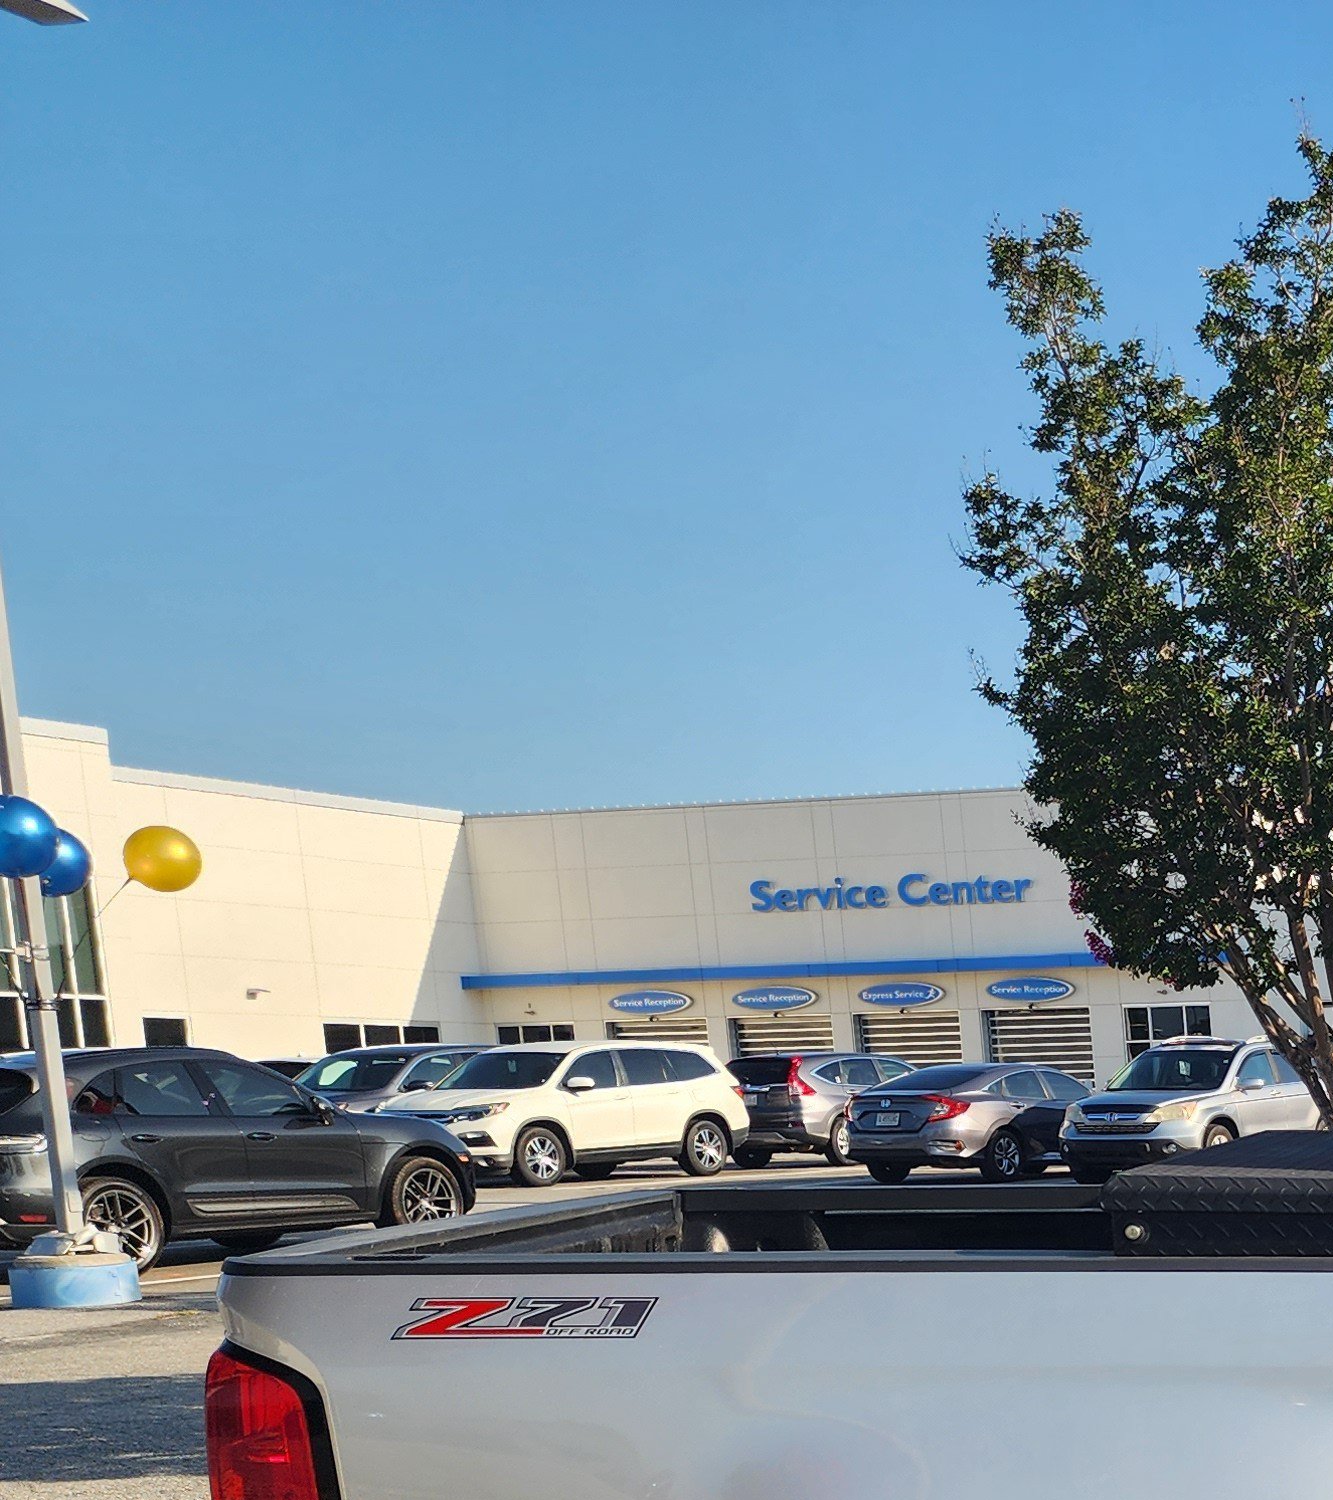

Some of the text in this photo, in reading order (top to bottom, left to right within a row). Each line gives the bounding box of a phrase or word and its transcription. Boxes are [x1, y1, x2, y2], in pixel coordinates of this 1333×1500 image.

[749, 872, 1034, 913] Service Center
[862, 989, 925, 1002] Express Service
[991, 984, 1067, 996] Service Reception
[613, 997, 684, 1009] Service Reception
[737, 991, 810, 1004] Service Reception
[391, 1297, 658, 1339] Z71
[545, 1327, 635, 1336] OFF ROAD
